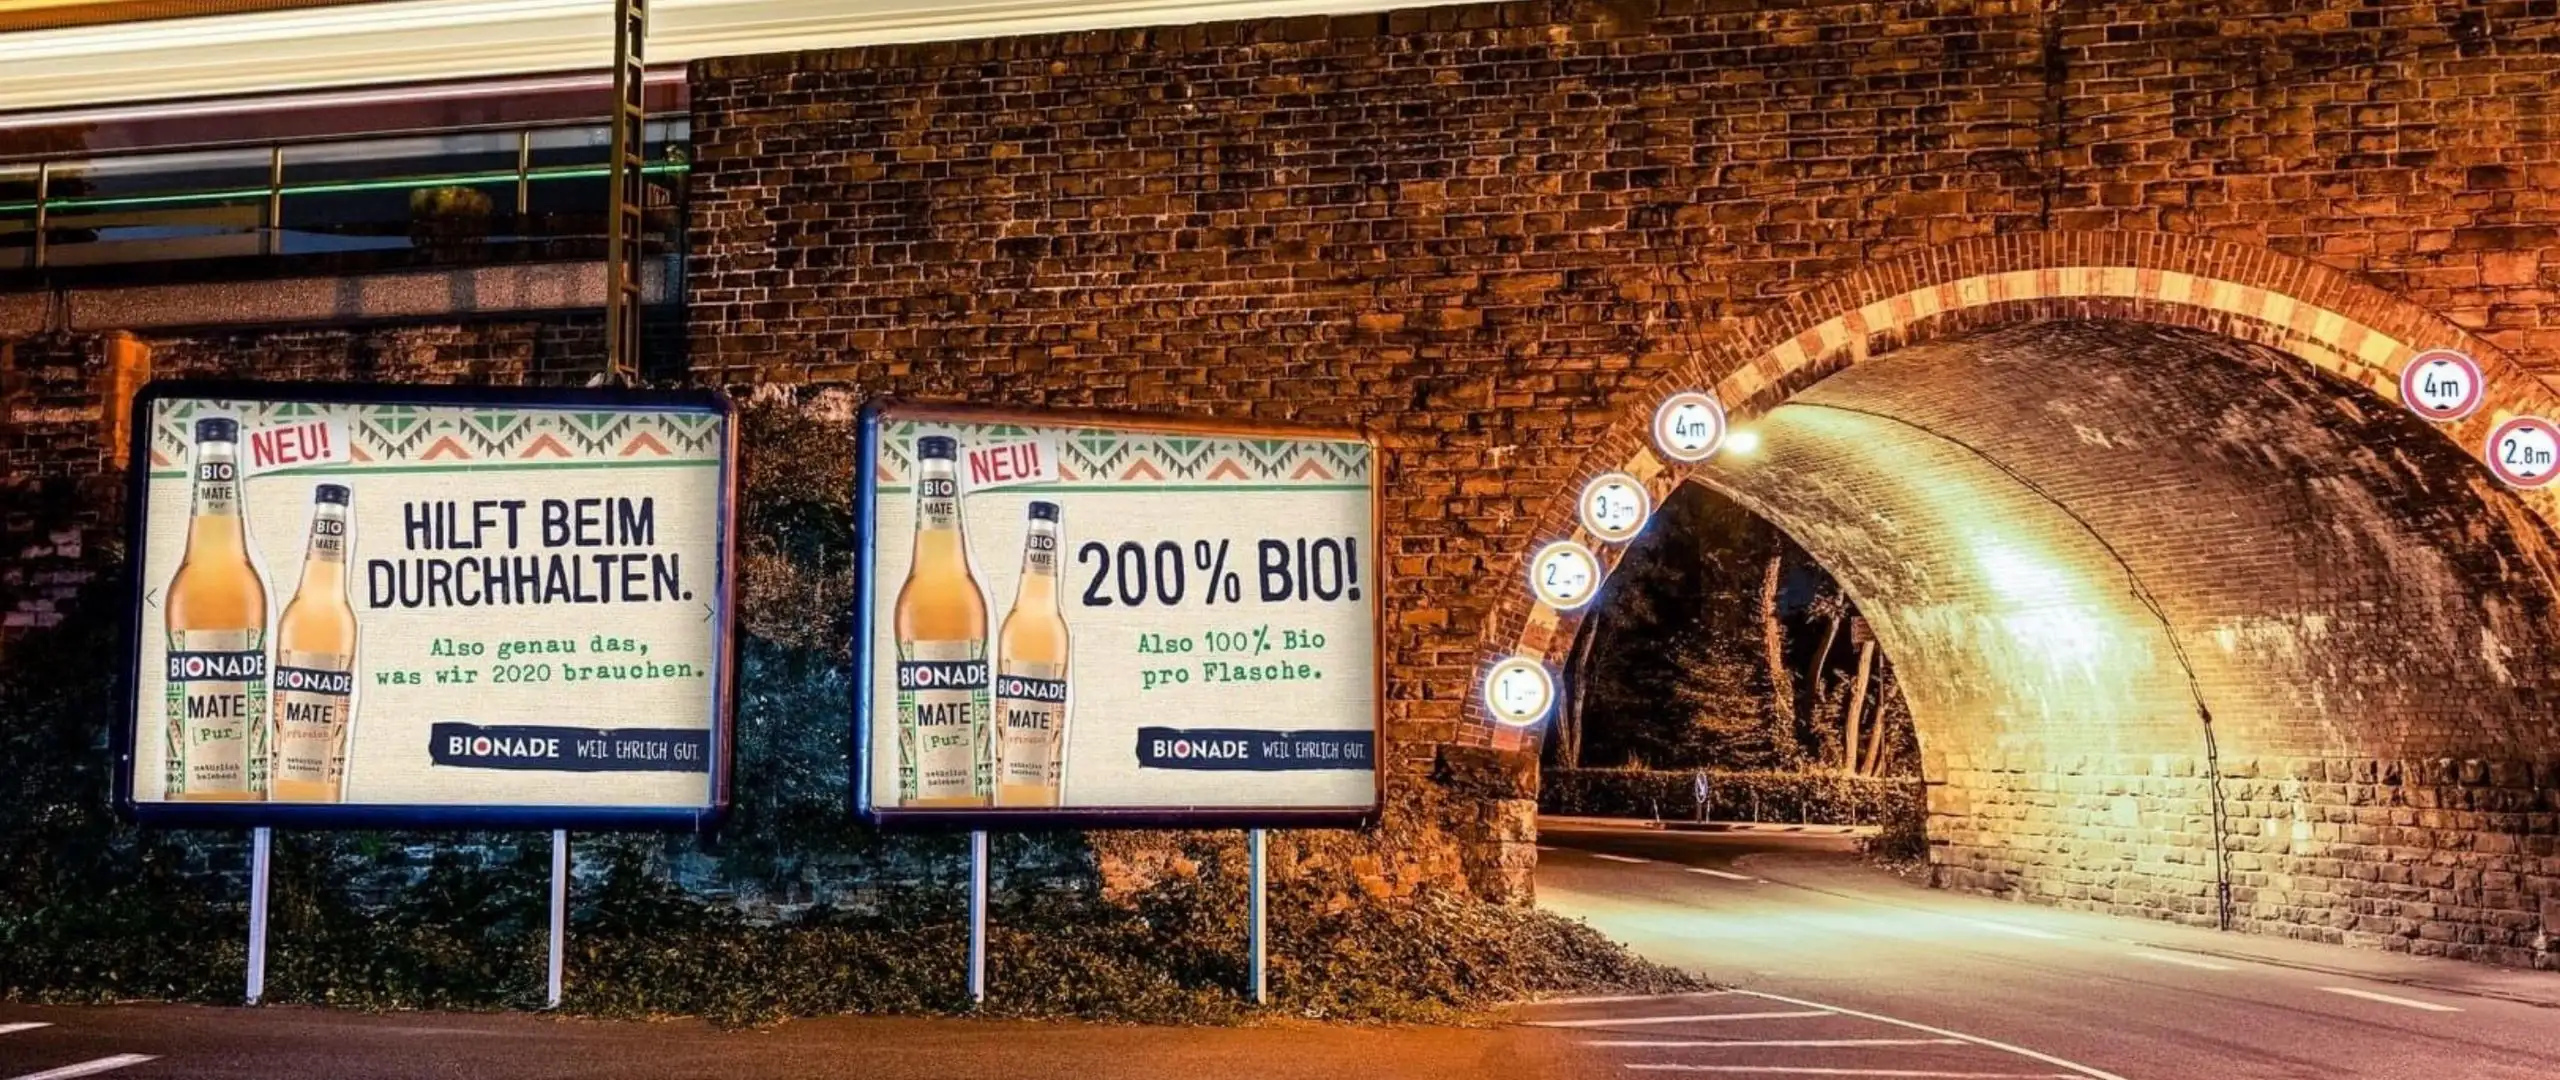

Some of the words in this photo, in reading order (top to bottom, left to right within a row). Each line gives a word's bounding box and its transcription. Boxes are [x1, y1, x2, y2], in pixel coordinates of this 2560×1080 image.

[2424, 373, 2459, 398] 4m
[1675, 415, 1706, 437] 4m
[252, 422, 331, 467] NEU!
[201, 464, 233, 480] BIO
[969, 442, 1042, 485] NEU!
[201, 486, 232, 500] MATE
[924, 481, 953, 496] BIO
[924, 502, 953, 515] MATE
[316, 520, 343, 535] BIO
[404, 500, 526, 550] HILFT
[542, 497, 654, 547] BEIM
[315, 539, 341, 551] MATE
[1030, 536, 1054, 550] BIO
[368, 553, 693, 609] DURCHHALTEN.
[1078, 538, 1241, 607] 200%
[1258, 537, 1360, 602] BIO!
[430, 638, 485, 658] Also
[498, 639, 576, 660] genau
[590, 635, 649, 656] das,
[1138, 633, 1193, 653] Also
[1205, 624, 1271, 656] 100%
[1283, 629, 1325, 650] Bio
[170, 654, 265, 678] BIONADE
[376, 670, 421, 685] was
[436, 666, 477, 683] wir
[492, 664, 550, 682] 2020
[564, 660, 704, 681] brauchen.
[901, 664, 988, 687] BIONADE
[1142, 666, 1189, 690] pro
[1203, 660, 1322, 683] Flasche.
[276, 670, 351, 693] BIONADE
[998, 679, 1066, 699] BIONADE
[187, 694, 246, 718] MATE
[286, 702, 333, 723] MATE
[918, 702, 971, 726] MATE
[1008, 709, 1051, 729] MATE
[450, 736, 560, 758] BIONADE
[576, 740, 609, 758] WEIL
[616, 740, 667, 760] EHRLICH
[1153, 739, 1249, 759] BIONADE
[1263, 740, 1290, 758] WEIL
[1295, 740, 1339, 759] EHRLICH
